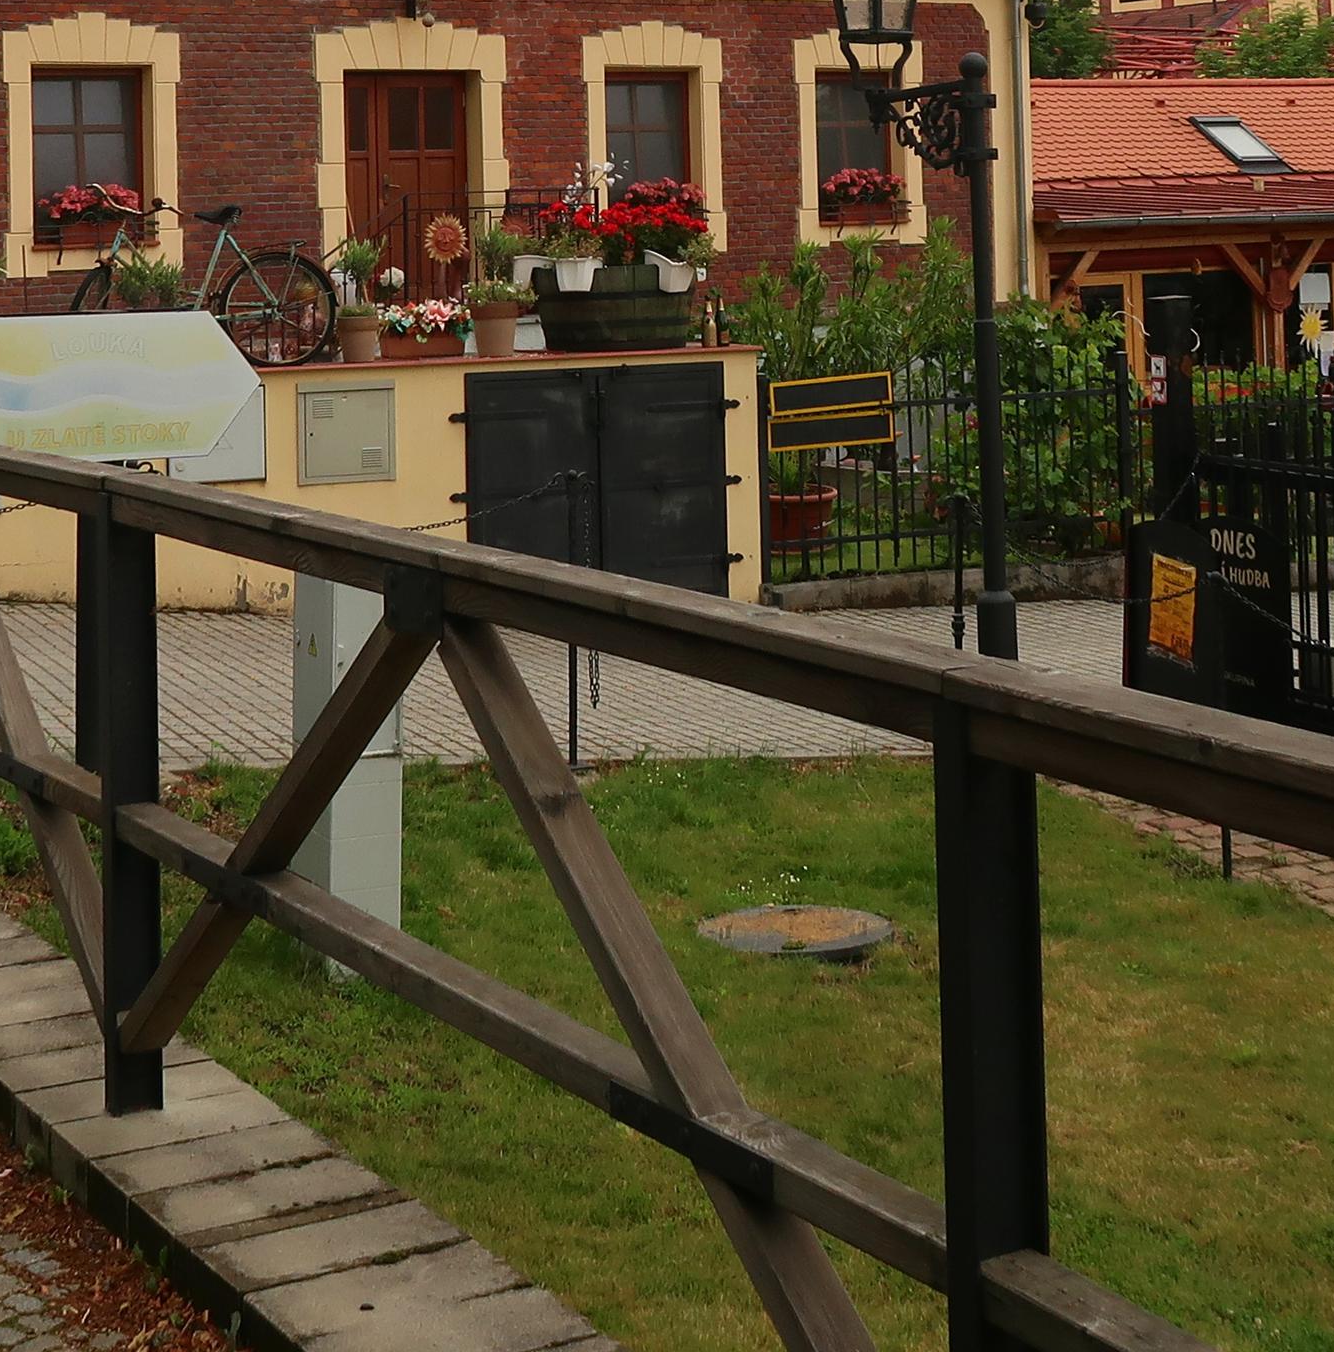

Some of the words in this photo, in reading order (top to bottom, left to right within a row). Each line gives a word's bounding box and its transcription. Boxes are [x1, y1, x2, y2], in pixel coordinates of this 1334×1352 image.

[51, 332, 148, 361] LOUKA
[32, 422, 106, 448] ZLATÉ
[113, 421, 191, 445] STOKY
[1210, 528, 1256, 559] DNES
[1229, 566, 1271, 589] HUDBA
